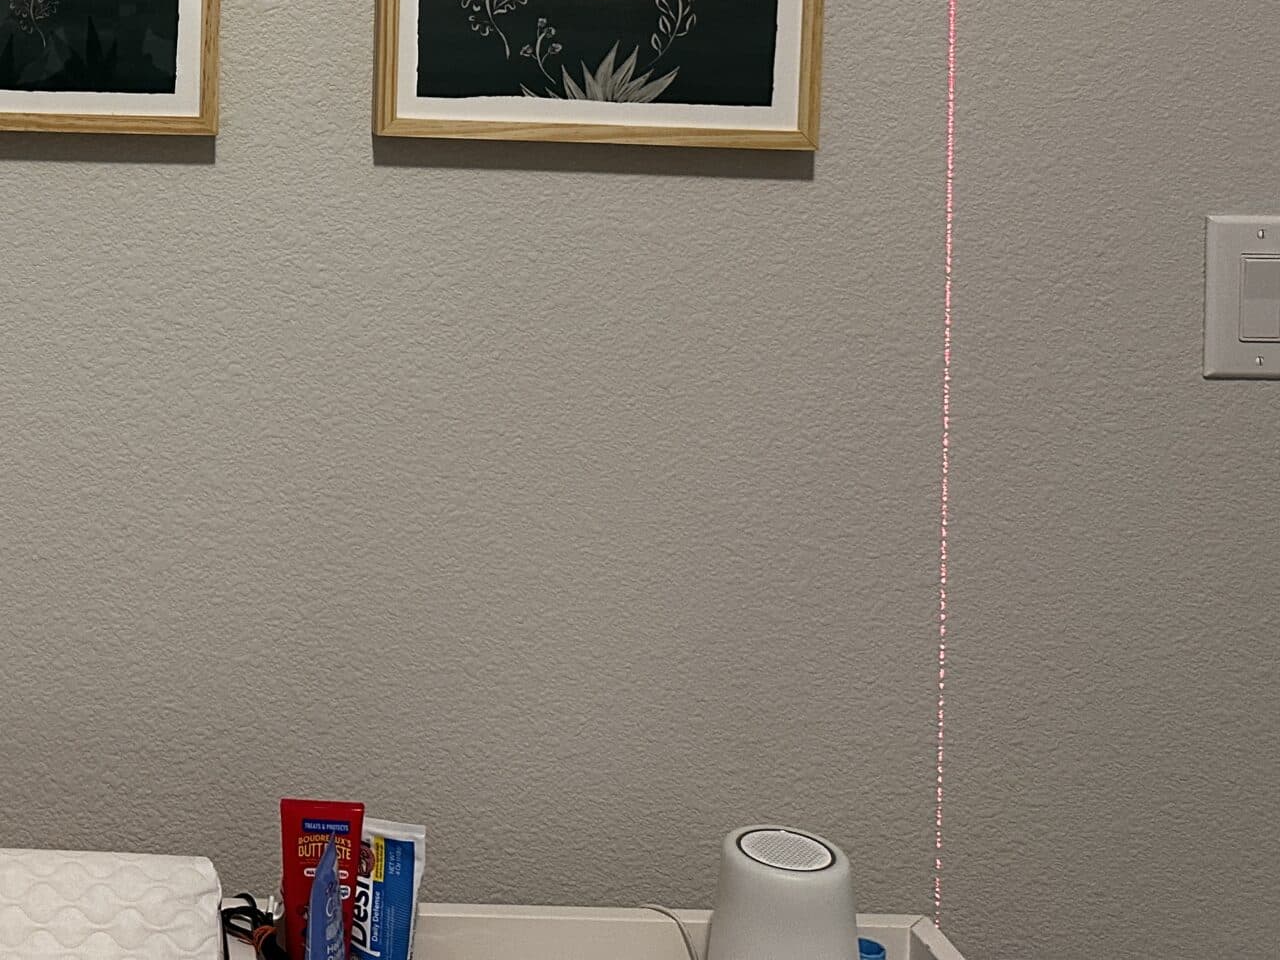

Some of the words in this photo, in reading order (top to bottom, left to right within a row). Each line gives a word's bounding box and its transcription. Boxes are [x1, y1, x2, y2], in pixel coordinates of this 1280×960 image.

[298, 834, 352, 847] BOUDREUX'S
[298, 843, 323, 857] BUTT
[373, 890, 381, 922] Defense
[372, 924, 380, 942] Daily
